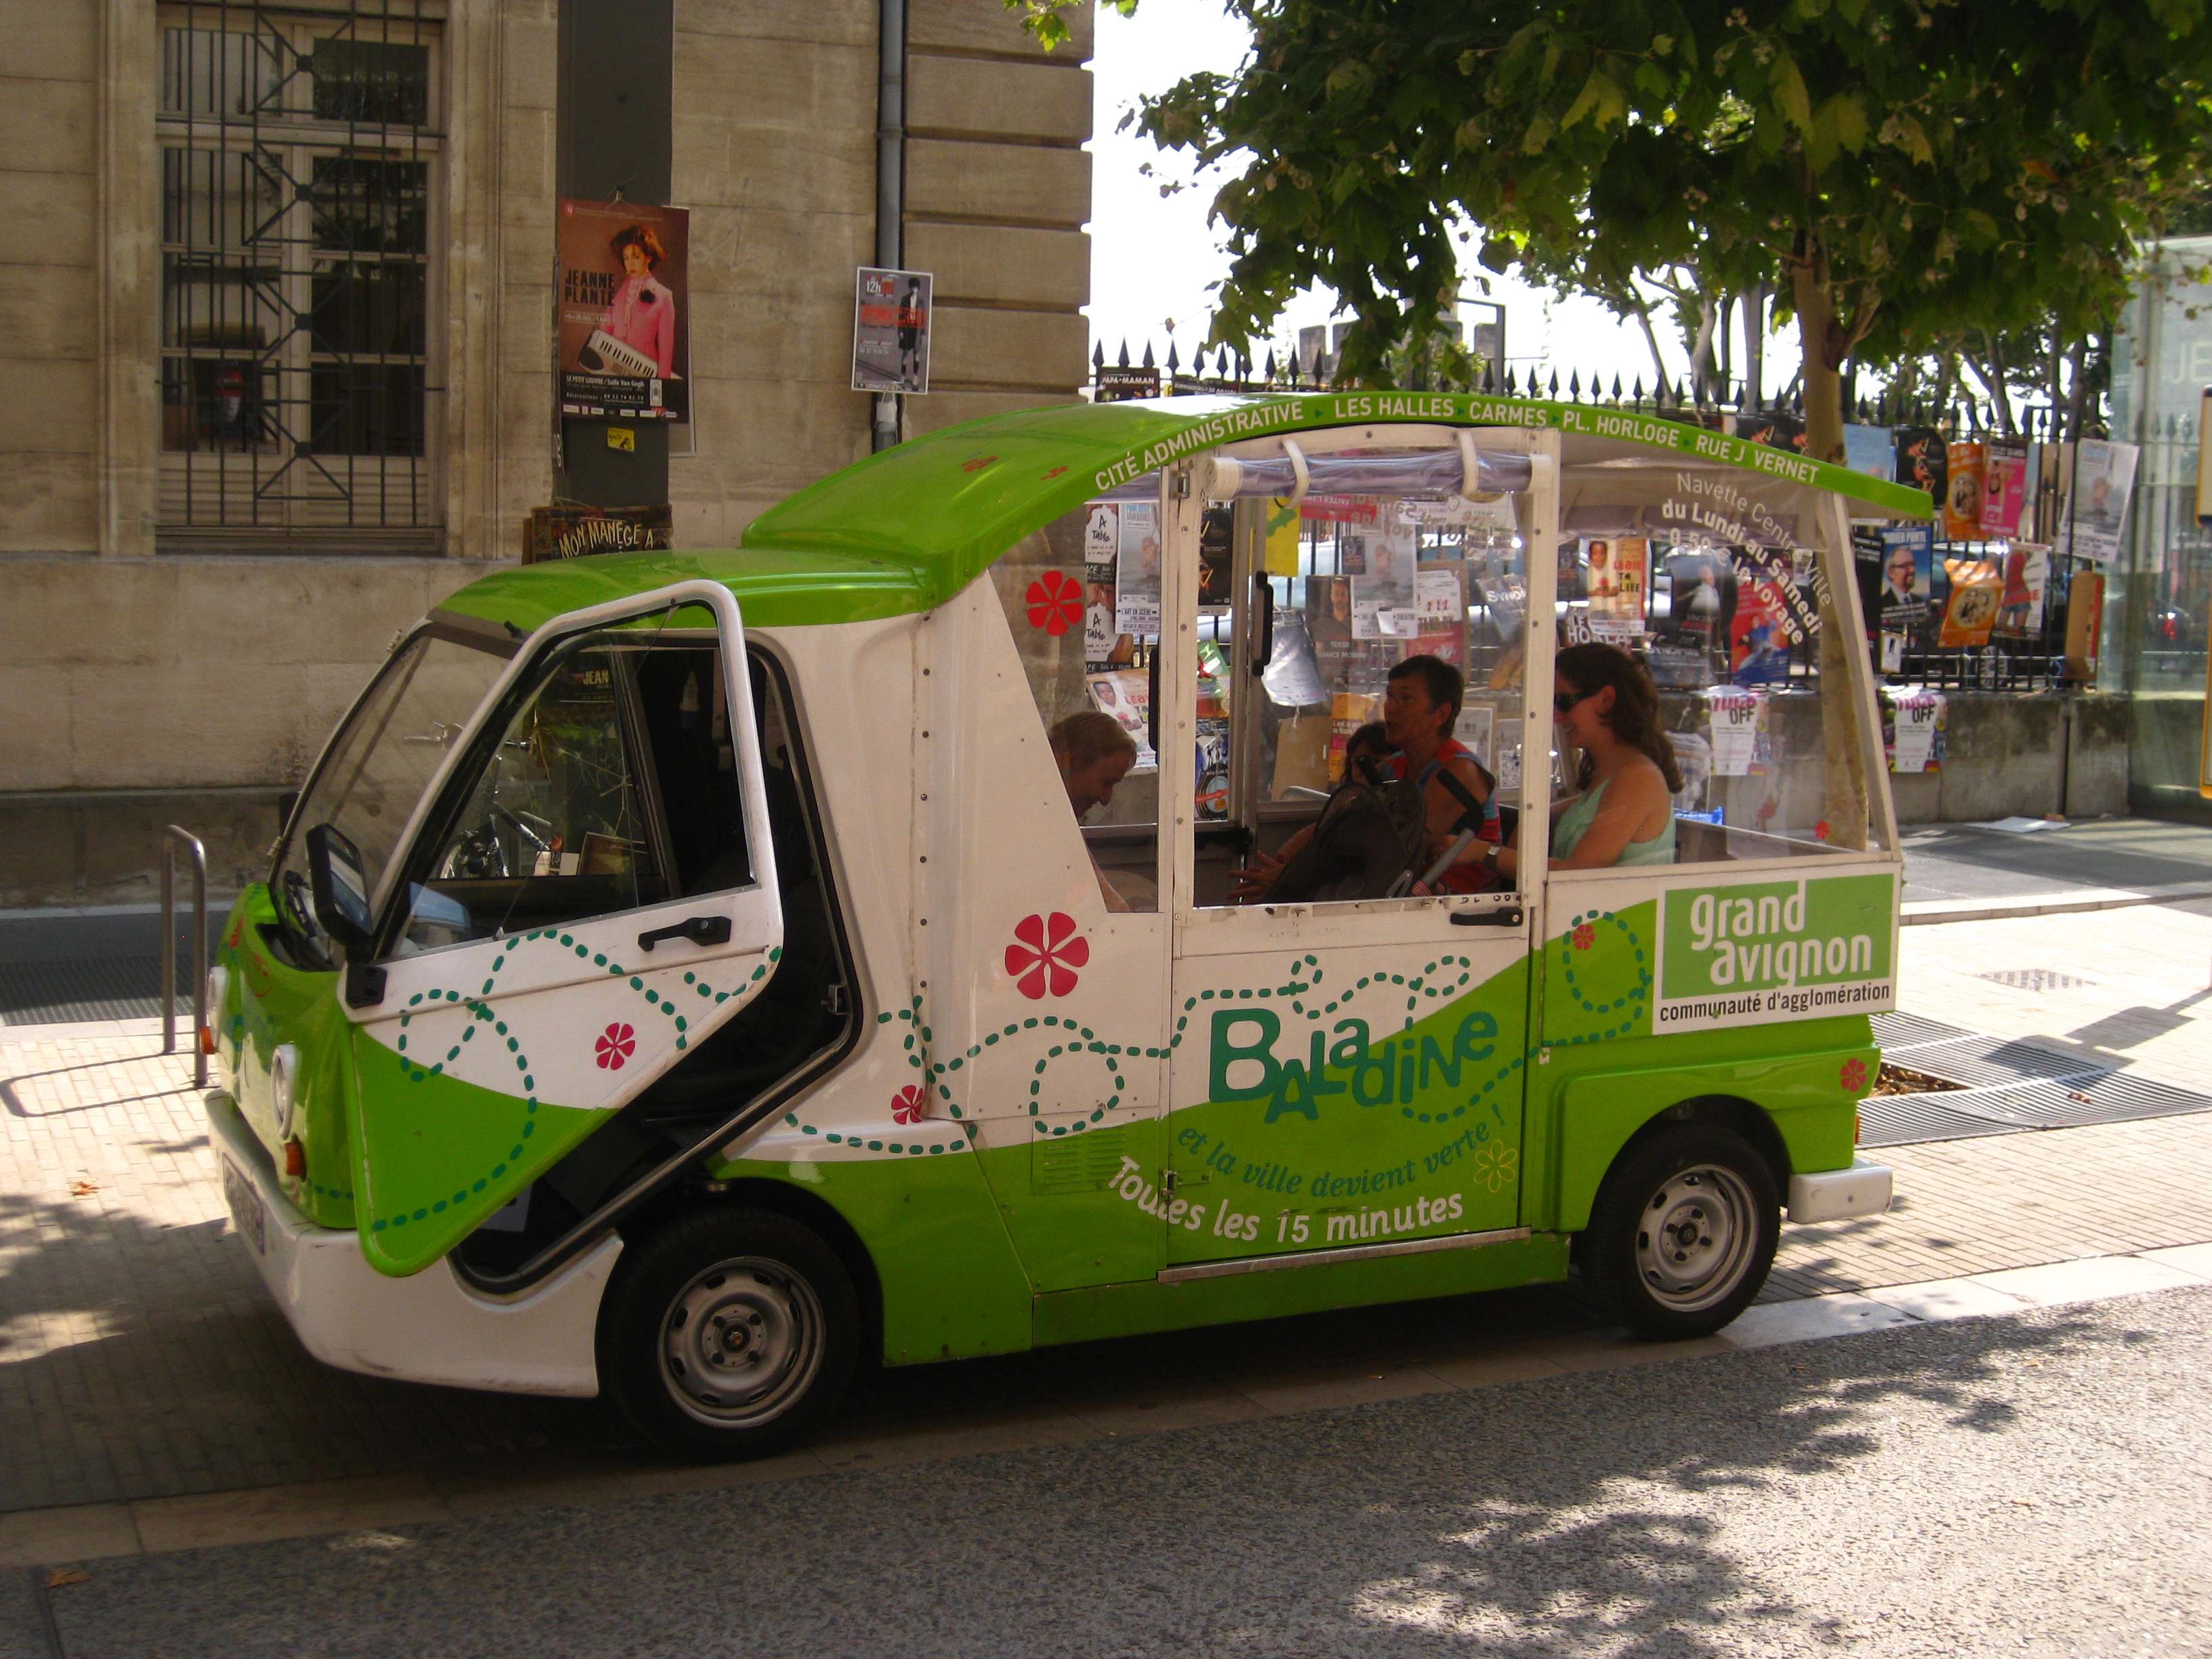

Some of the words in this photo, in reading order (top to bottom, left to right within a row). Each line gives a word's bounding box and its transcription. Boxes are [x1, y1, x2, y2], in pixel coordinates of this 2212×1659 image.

[565, 269, 615, 289] JEANNE
[565, 285, 615, 306] PLANTE
[1102, 376, 1155, 385] PAPA-MAMAN
[1334, 397, 1372, 419] LES
[1378, 397, 1455, 417] HALLES
[1469, 401, 1547, 427] CARMES
[1094, 451, 1141, 491] CITÉ
[1143, 401, 1305, 470] ADMINISTRATIVE
[1563, 409, 1591, 432] PL.
[1596, 415, 1680, 448] HORLOGE
[1696, 434, 1732, 460] RUE
[1734, 445, 1746, 462] J
[1754, 449, 1820, 484] VERNET
[1677, 472, 1748, 511] Navette
[1092, 529, 1111, 542] Table
[1099, 514, 1107, 529] A
[559, 524, 586, 559] MON
[644, 528, 654, 549] A
[1662, 498, 1687, 520] du
[1693, 501, 1747, 546] Lundi
[1745, 541, 1769, 565] au
[1767, 558, 1823, 634] Samedi
[1092, 613, 1102, 628] A
[1753, 577, 1803, 644] voyage
[1086, 628, 1106, 640] Table
[1729, 707, 1755, 725] OFF
[1912, 704, 1936, 724] OFF
[1690, 879, 1807, 951] grand
[1709, 934, 1872, 988] avignon
[1660, 994, 1761, 1023] communauté
[1767, 984, 1890, 1013] d'agglomération
[1178, 1126, 1209, 1154] et
[1206, 1142, 1237, 1176] la
[1242, 1161, 1303, 1197] ville
[1310, 1158, 1417, 1198] devient
[1426, 1120, 1490, 1175] verte
[1213, 1198, 1261, 1242] les
[1277, 1208, 1311, 1244] 15
[1326, 1193, 1465, 1243] minutes
